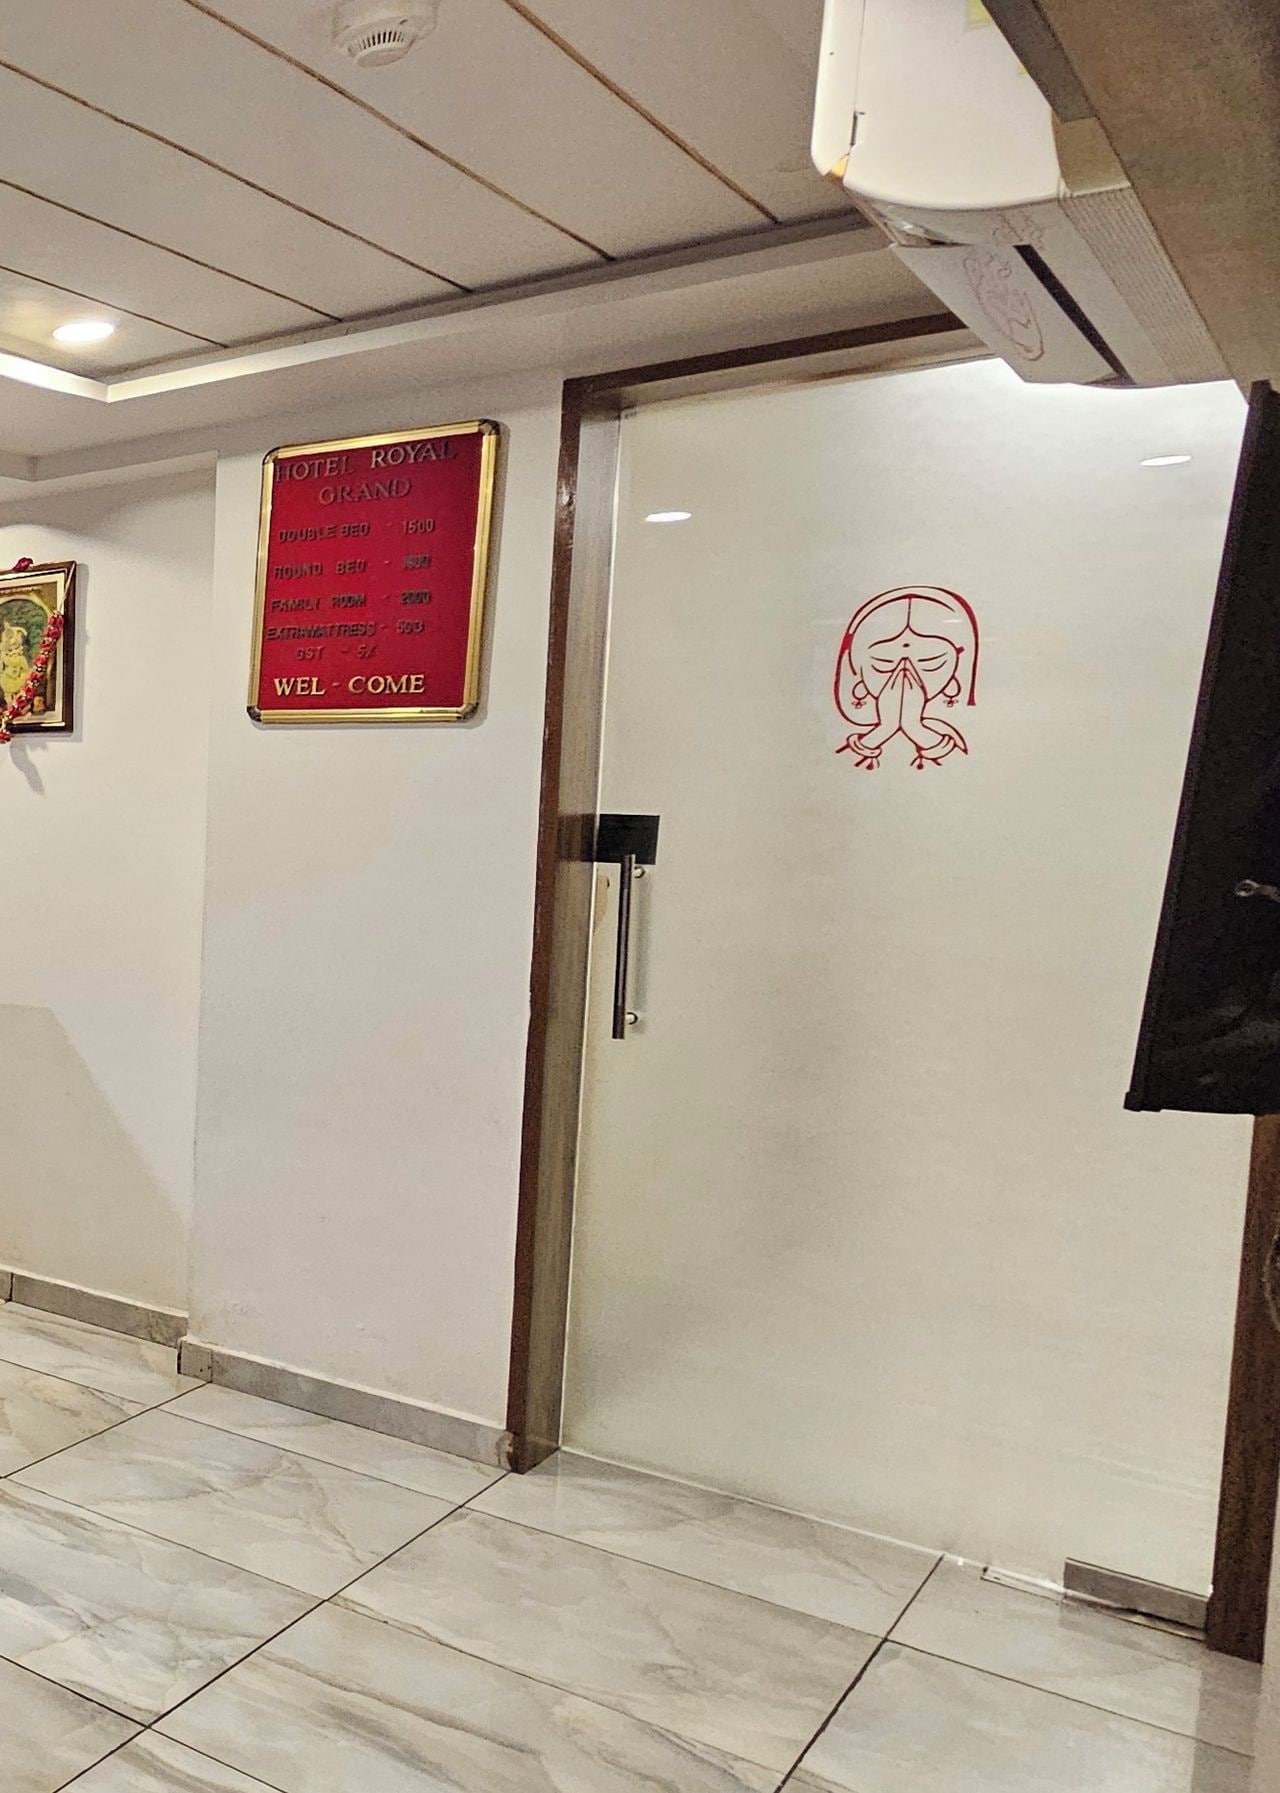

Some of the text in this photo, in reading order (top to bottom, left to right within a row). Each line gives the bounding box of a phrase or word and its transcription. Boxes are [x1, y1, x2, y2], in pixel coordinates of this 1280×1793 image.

[275, 440, 456, 481] HOTEL ROYAL
[319, 478, 413, 505] GRAND
[279, 525, 337, 543] DOUBLE
[341, 522, 371, 537] BED
[403, 519, 436, 534] 1500
[275, 563, 323, 580] ROUND
[336, 560, 367, 576] BED
[271, 598, 320, 613] FAMILY
[274, 677, 326, 697] WEL
[348, 674, 426, 695] COME
